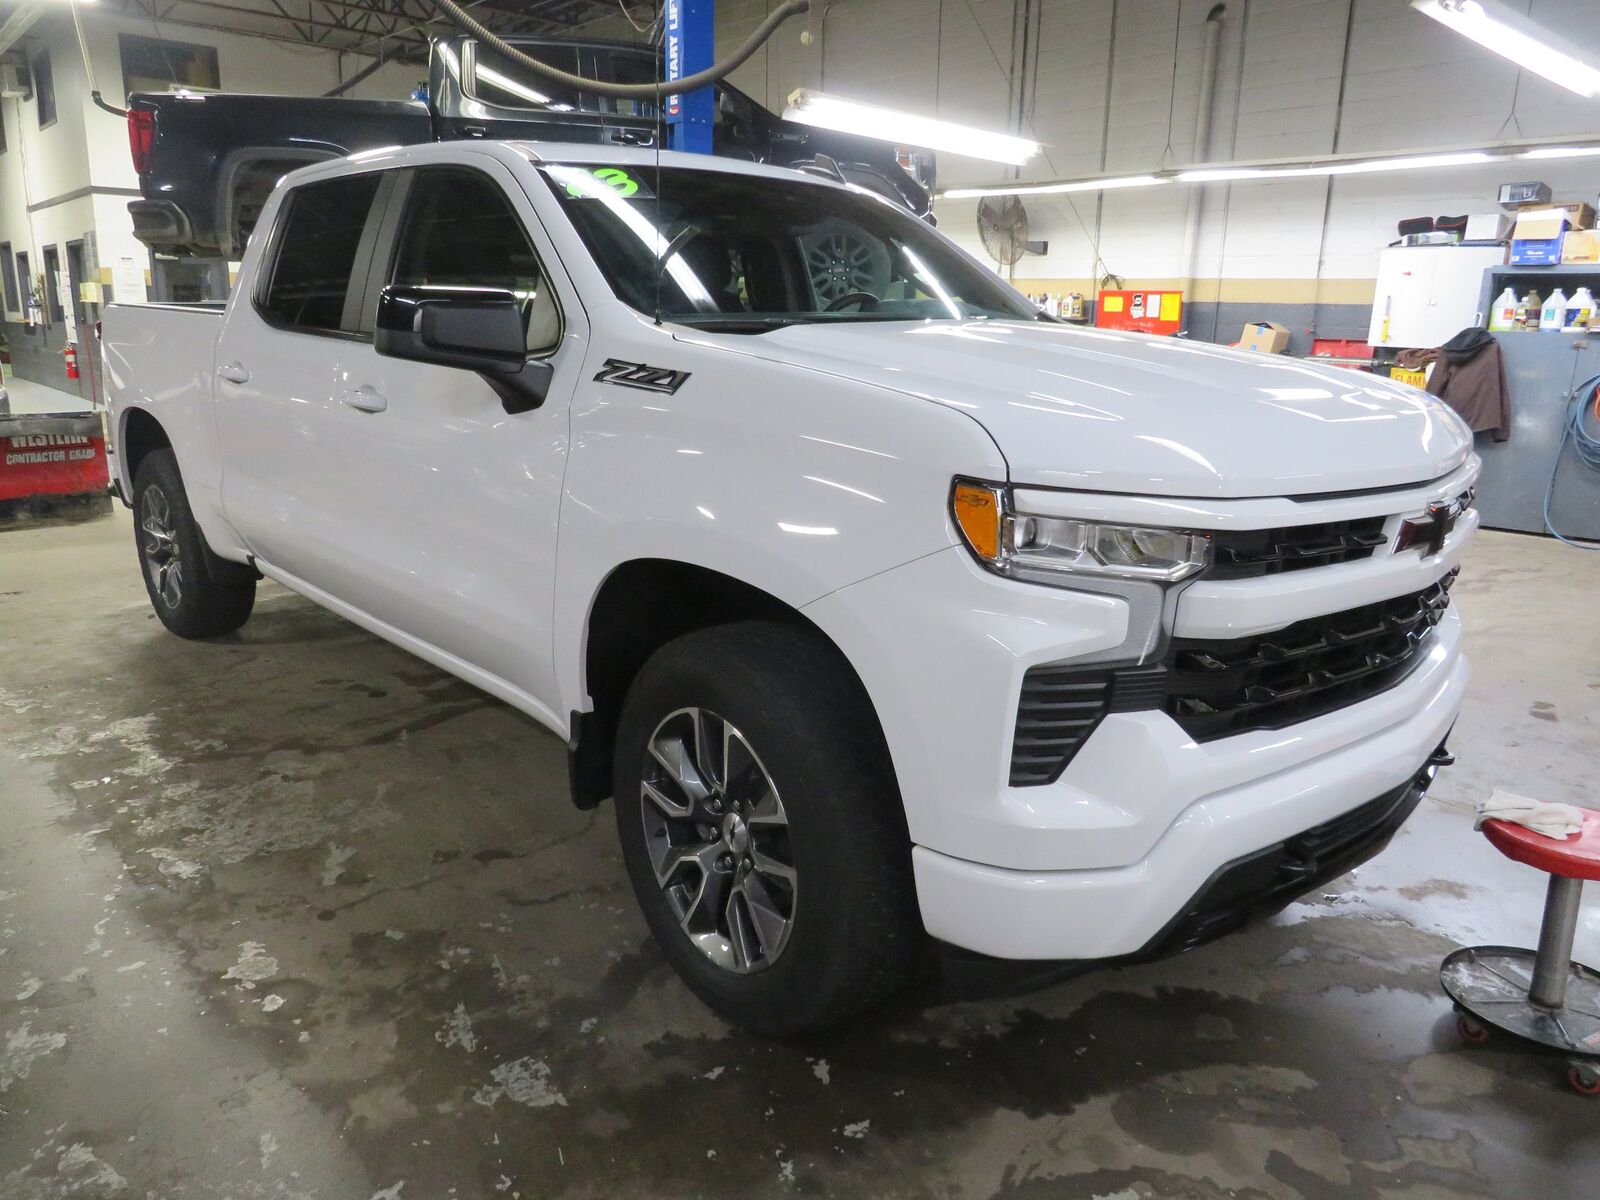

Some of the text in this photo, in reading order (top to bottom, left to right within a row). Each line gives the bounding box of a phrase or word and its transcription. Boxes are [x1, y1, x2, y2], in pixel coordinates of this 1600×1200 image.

[669, 0, 679, 105] RTARY LIF
[6, 451, 66, 465] CONTRACTOR
